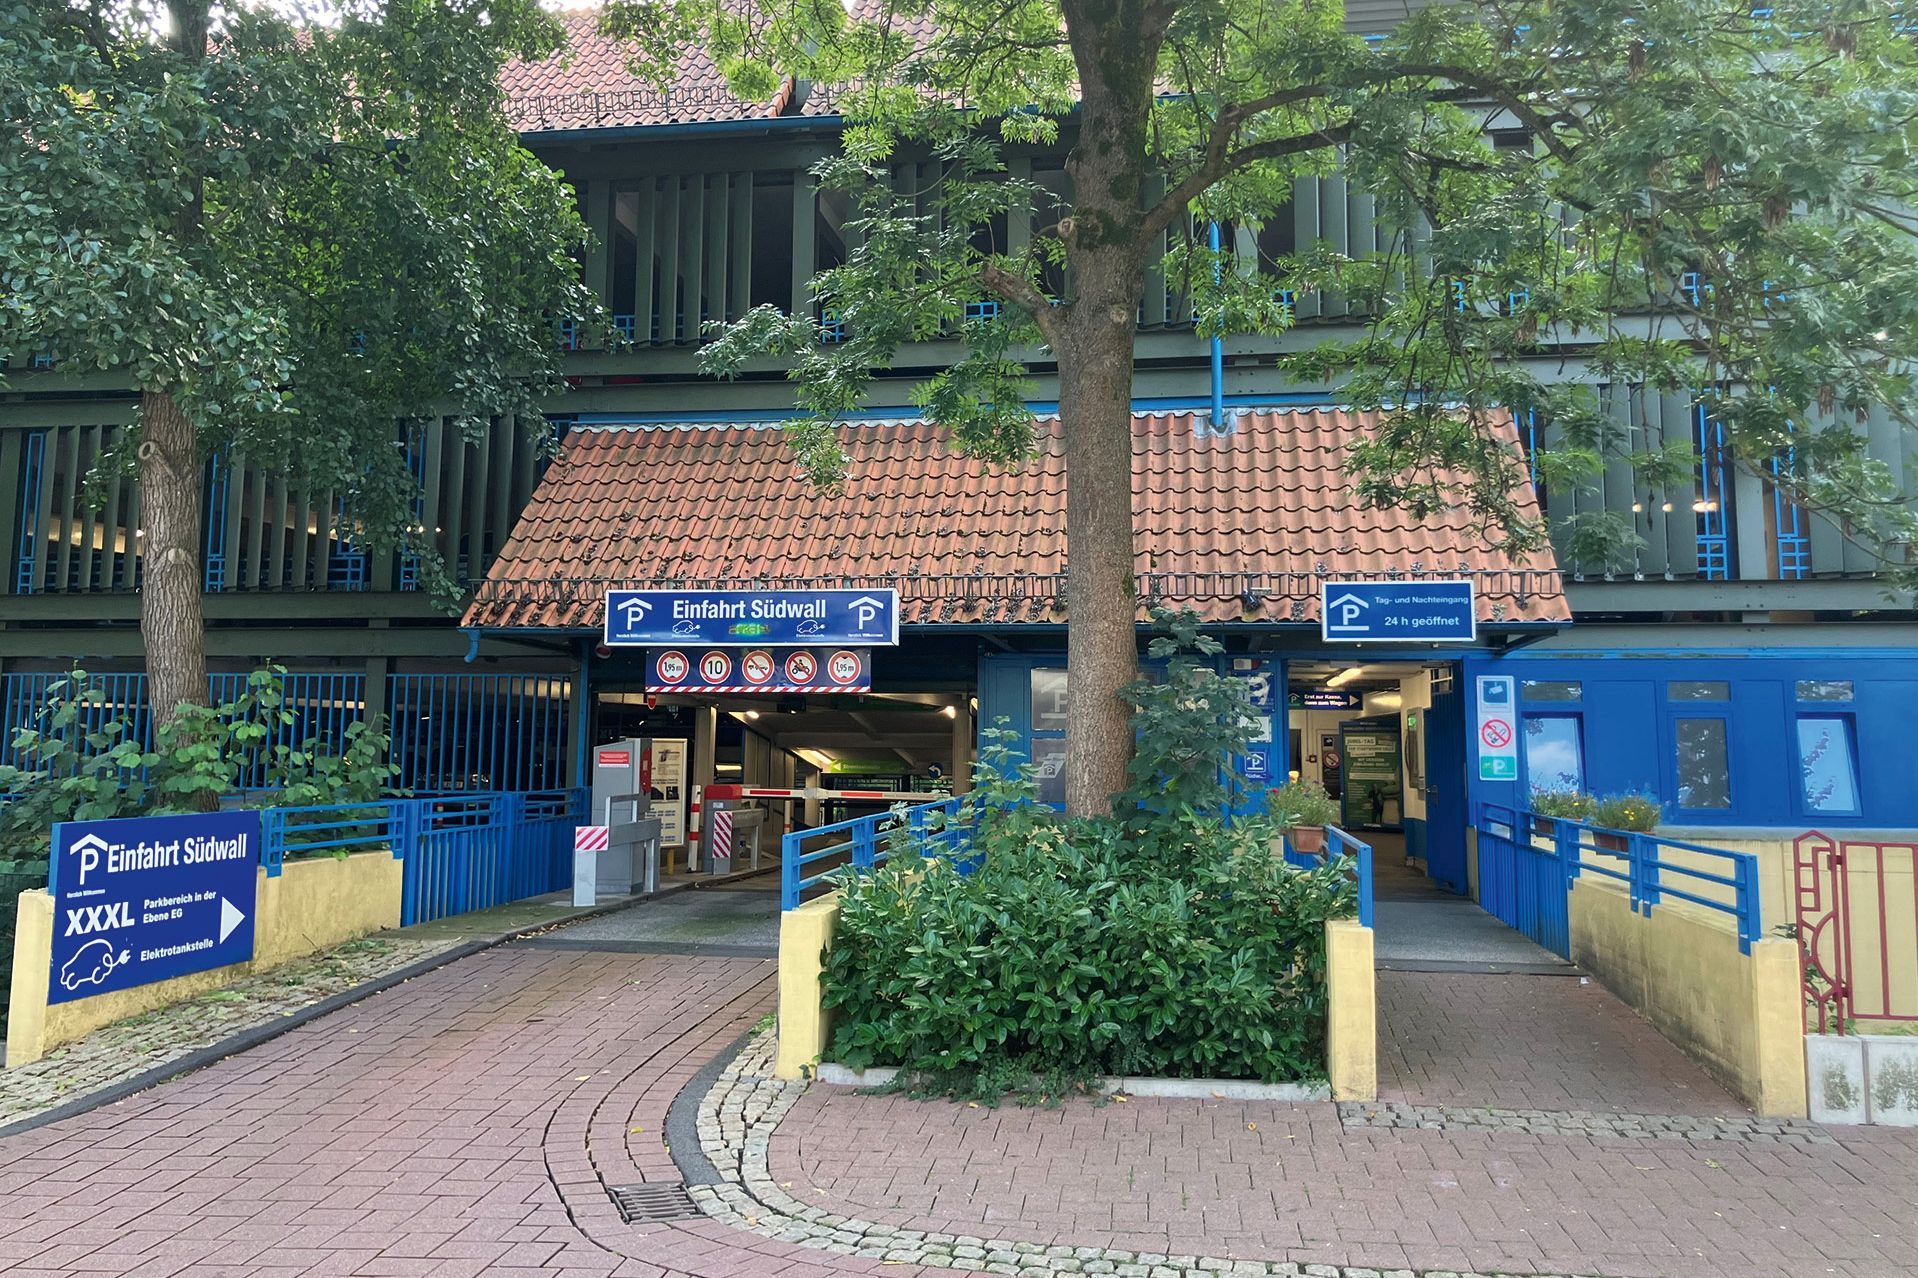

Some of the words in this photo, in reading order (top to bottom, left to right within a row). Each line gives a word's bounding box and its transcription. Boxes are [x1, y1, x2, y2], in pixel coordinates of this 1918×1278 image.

[1375, 596, 1393, 605] Tag-
[1396, 596, 1410, 604] und
[1412, 596, 1469, 605] Nachteingang
[672, 599, 746, 619] Einfahrt
[750, 599, 826, 619] Südwall
[1384, 617, 1399, 626] 24
[1401, 616, 1409, 626] h
[1411, 616, 1460, 628] geöffnet
[664, 661, 676, 673] 1,95
[708, 660, 723, 675] 10
[836, 662, 847, 673] 1,95
[107, 840, 180, 873] Einfahrt
[183, 833, 247, 865] Südwall
[144, 895, 193, 910] Parkbereich
[194, 894, 202, 902] in
[203, 891, 216, 901] der
[64, 902, 135, 936] XXXL
[143, 911, 169, 924] Ebene
[171, 908, 183, 919] EG
[140, 939, 214, 962] Elektrotankstelle
